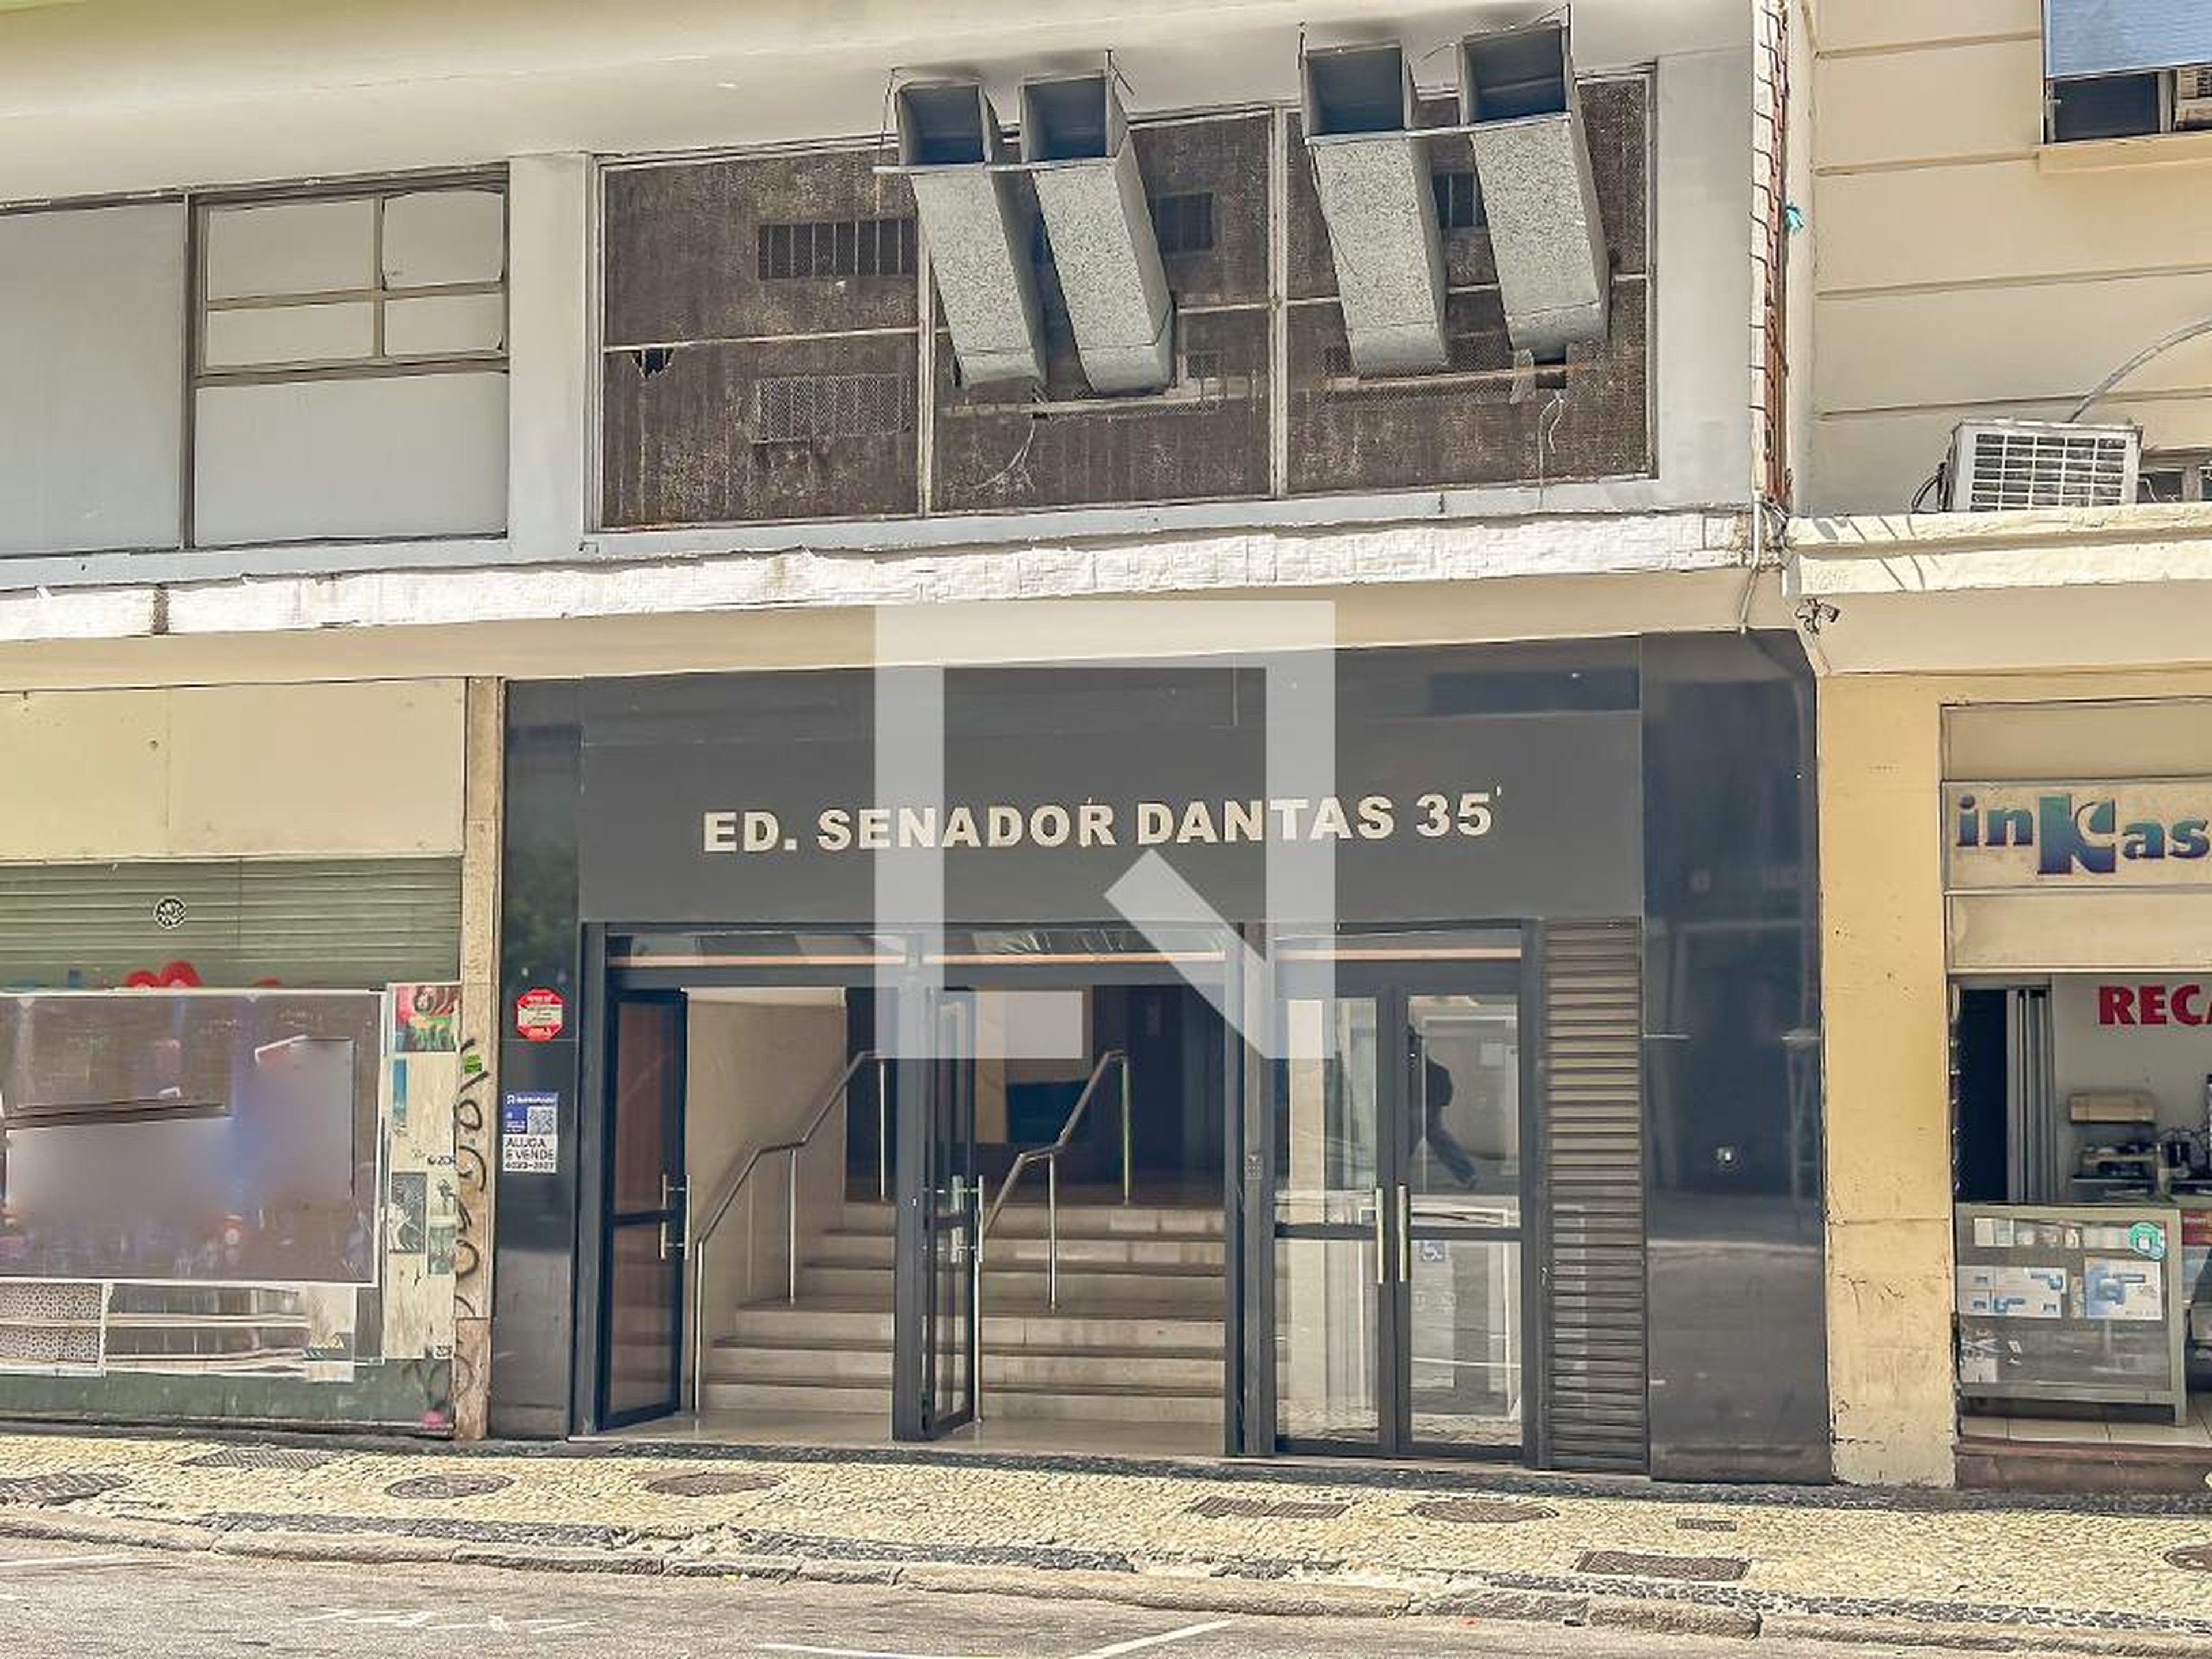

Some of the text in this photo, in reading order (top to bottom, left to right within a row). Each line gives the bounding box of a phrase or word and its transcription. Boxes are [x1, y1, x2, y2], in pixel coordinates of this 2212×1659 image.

[703, 792, 1493, 853] ED. SENADOR DANTAS 35
[2099, 984, 2212, 1025] REC
[505, 1137, 547, 1147] ALUGA
[506, 1148, 555, 1160] E VENDE
